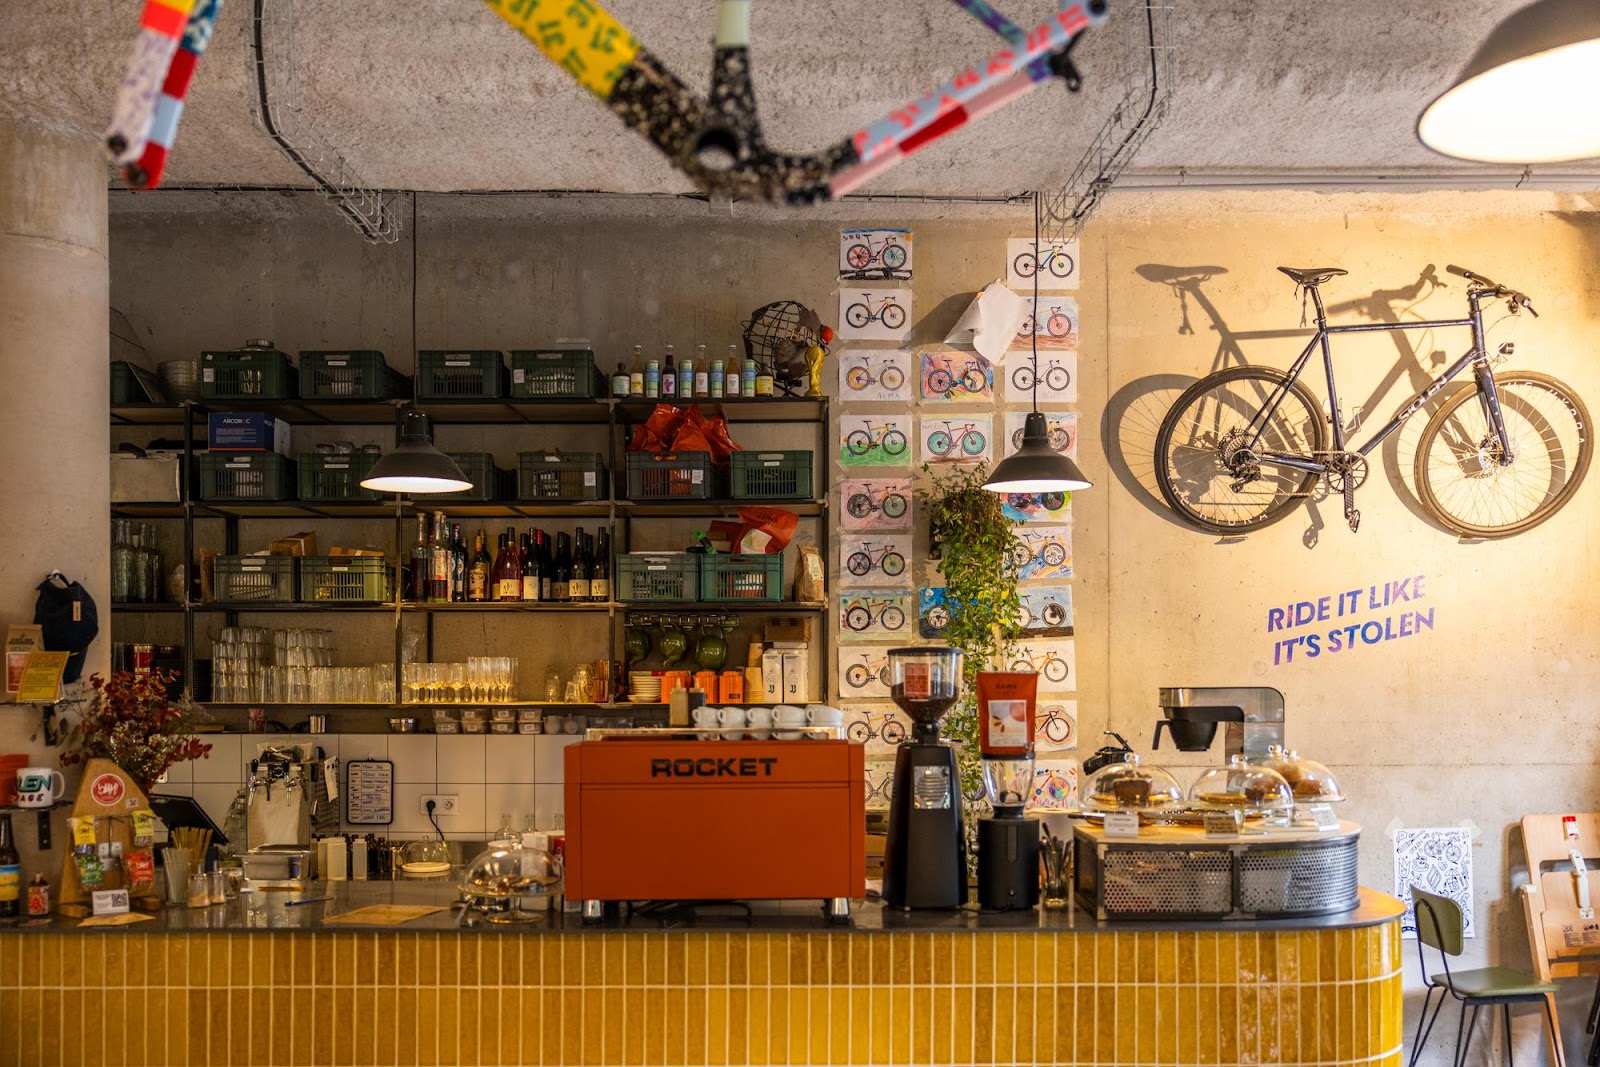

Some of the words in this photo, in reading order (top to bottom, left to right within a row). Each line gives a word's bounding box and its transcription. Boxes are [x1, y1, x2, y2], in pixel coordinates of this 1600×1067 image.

[1199, 513, 1269, 527] HYDRA
[1267, 596, 1331, 632] RIDE
[1338, 589, 1363, 617] IT
[1369, 575, 1426, 609] LIKE
[1274, 634, 1321, 665] IT'S
[1327, 607, 1435, 653] STOLEN
[651, 757, 778, 777] ROCKET
[18, 775, 52, 793] LEN
[18, 793, 44, 802] AGE
